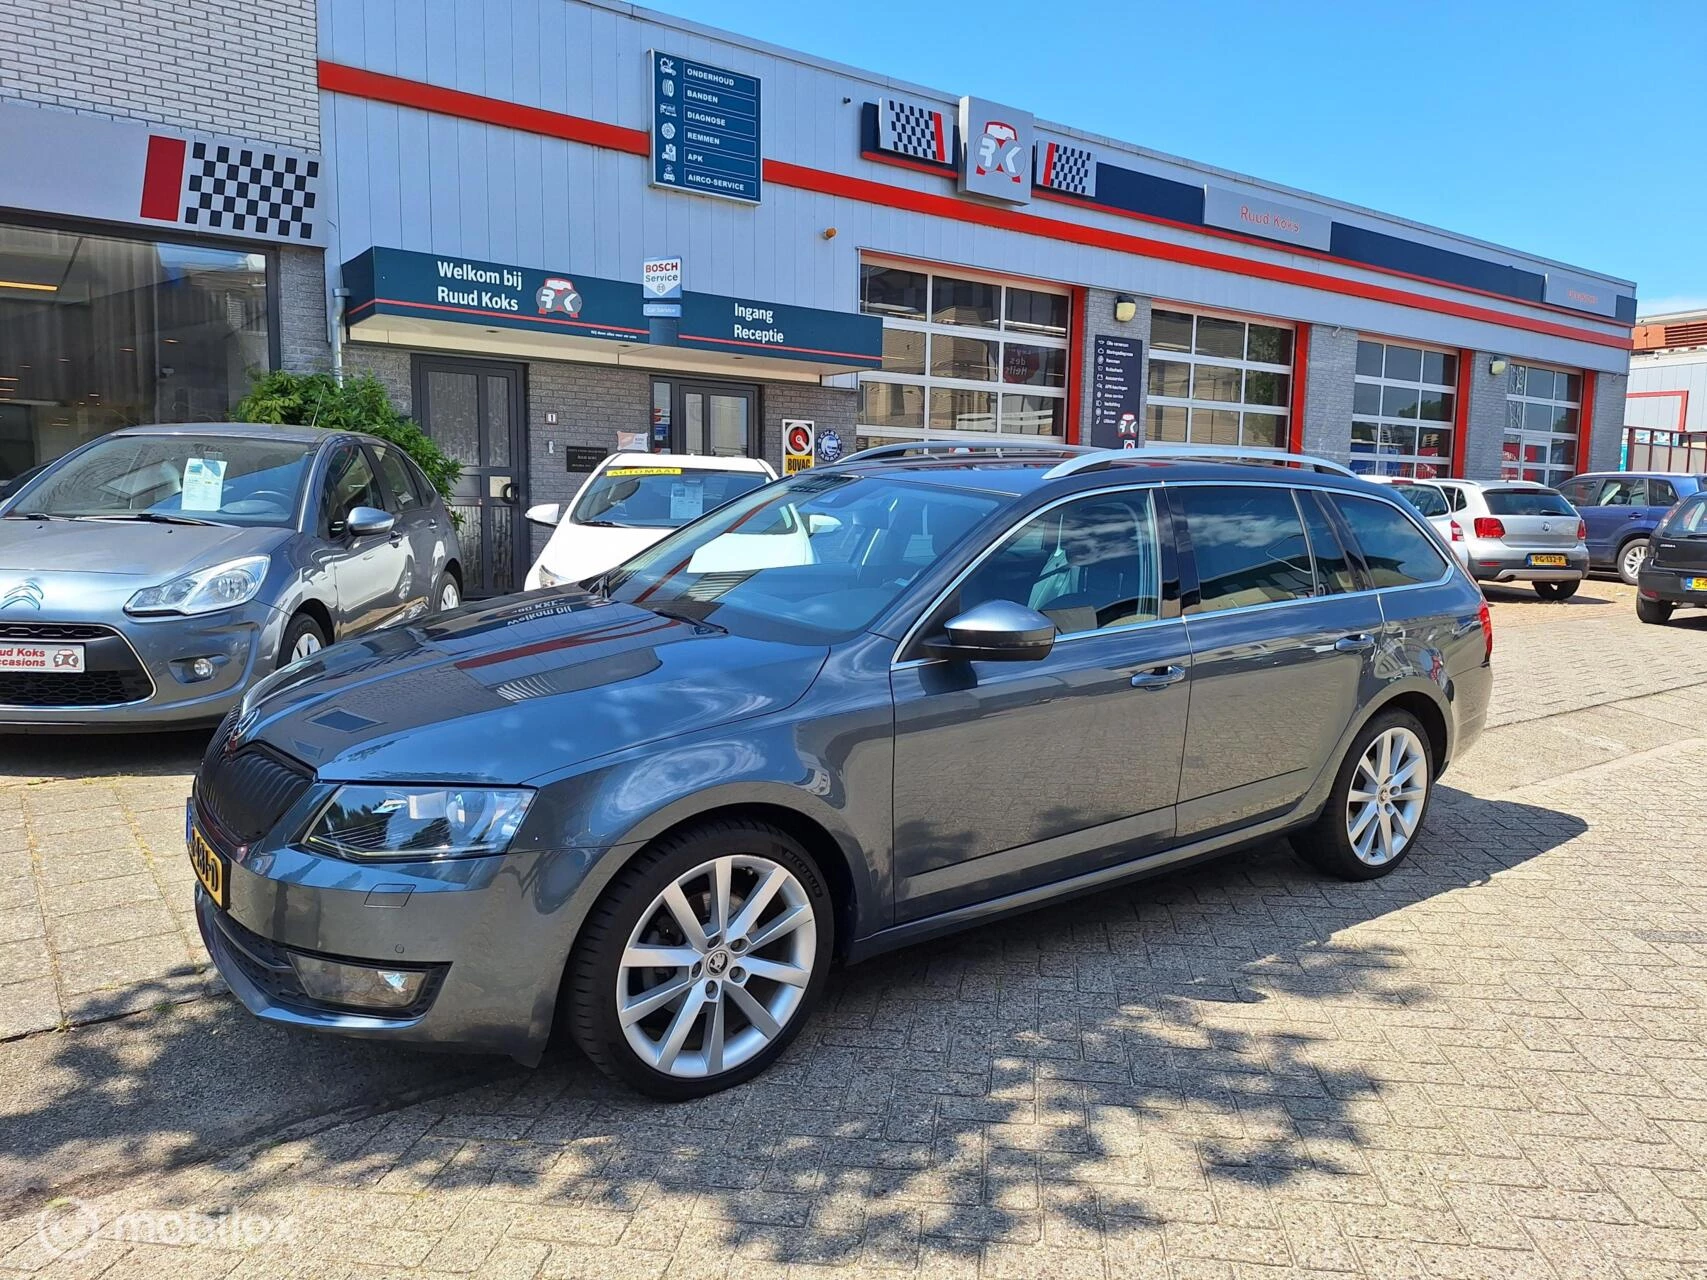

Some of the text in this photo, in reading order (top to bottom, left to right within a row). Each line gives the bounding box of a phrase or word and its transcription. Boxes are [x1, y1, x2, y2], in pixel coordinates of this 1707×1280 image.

[687, 68, 734, 86] ONDERHOUD
[687, 90, 718, 103] BANDEN
[687, 112, 726, 126] DIAGNOSE
[687, 132, 720, 145] REMMEN
[688, 153, 704, 163] APK
[688, 174, 745, 191] AIRCO-SERVICE
[1240, 205, 1301, 233] Ruud Koks
[645, 262, 678, 273] BOSCH
[437, 260, 522, 291] Welkom bij
[645, 273, 678, 283] Service
[437, 286, 519, 311] Ruud Koks
[734, 303, 773, 324] Ingang
[734, 324, 784, 344] Receptie
[787, 458, 811, 471] BOVAG
[17, 648, 46, 657] Koks
[0, 658, 46, 667] casions
